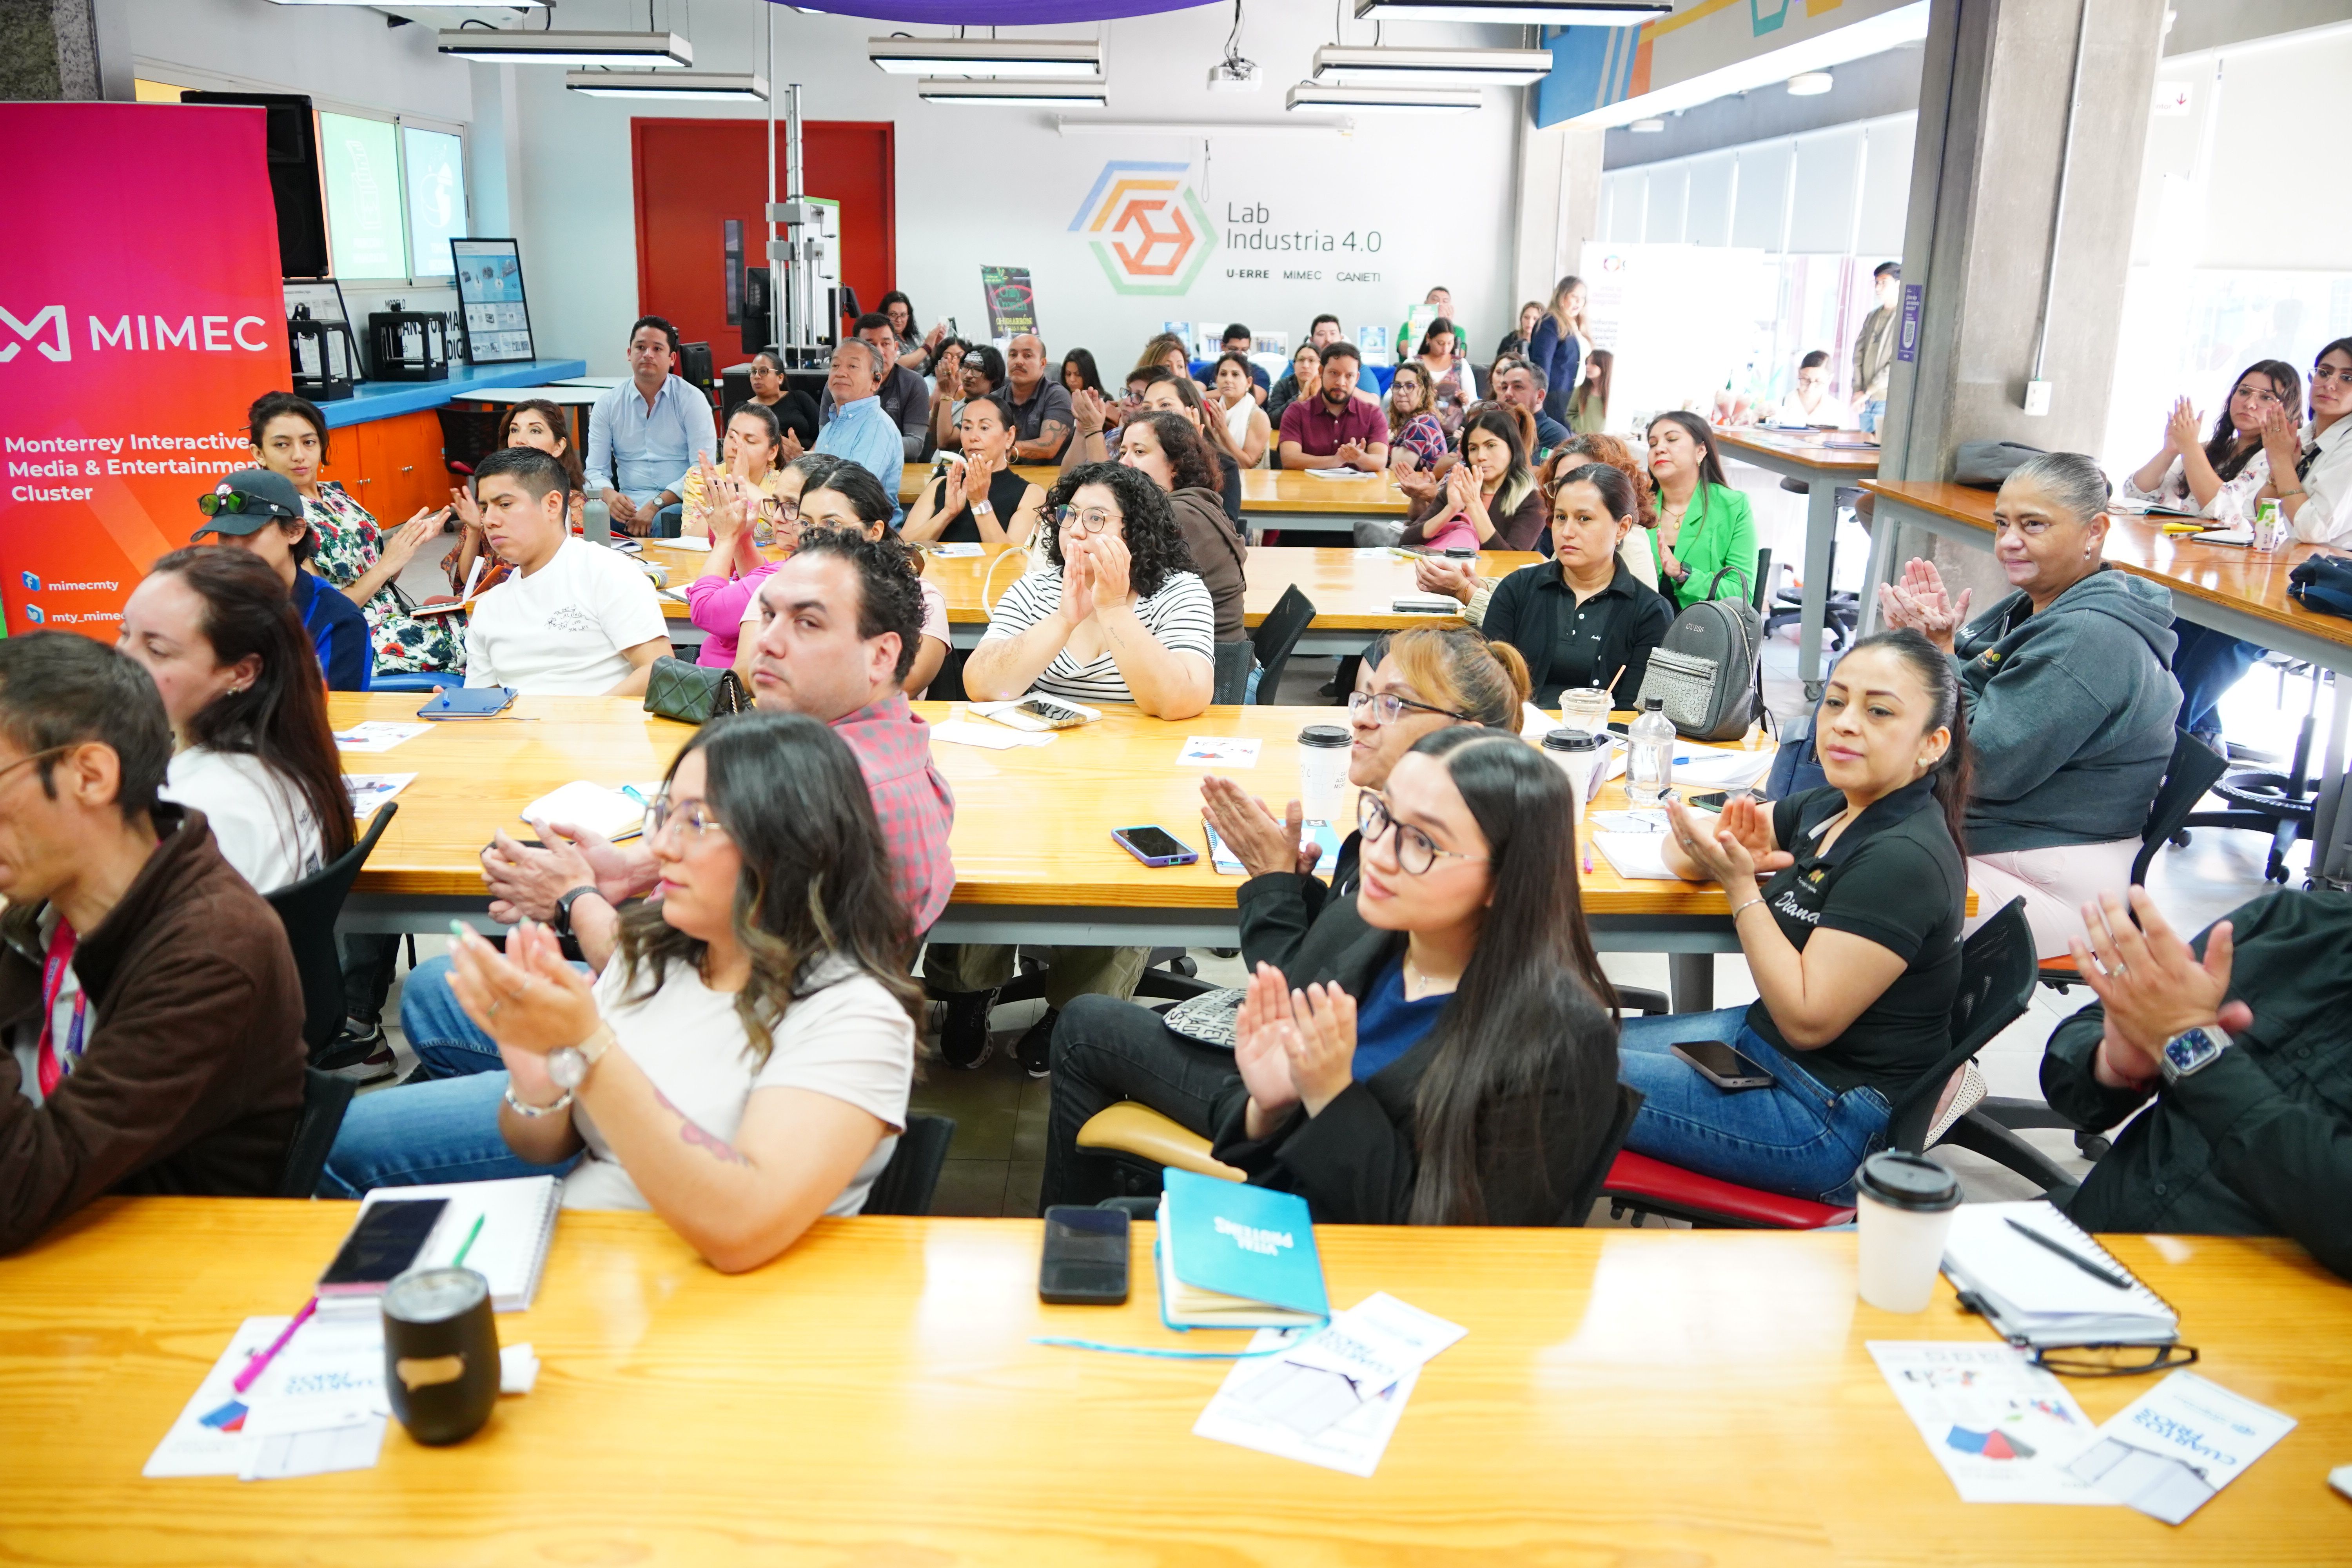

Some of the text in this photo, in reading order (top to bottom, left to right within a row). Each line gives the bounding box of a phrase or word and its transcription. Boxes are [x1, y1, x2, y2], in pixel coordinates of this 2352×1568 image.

[1228, 202, 1269, 224] Lab
[1227, 228, 1382, 253] Industria 4.0
[1227, 269, 1381, 282] U-ERRE MIMEC CANIETI
[90, 315, 269, 351] MIMEC
[6, 432, 249, 455] Monterrey Interactive
[10, 459, 78, 477] Media
[85, 459, 101, 475] &
[12, 484, 93, 502] Cluster
[49, 579, 119, 592] mimecmty
[1686, 623, 1704, 633] GUESS
[1774, 890, 1821, 925] Diana
